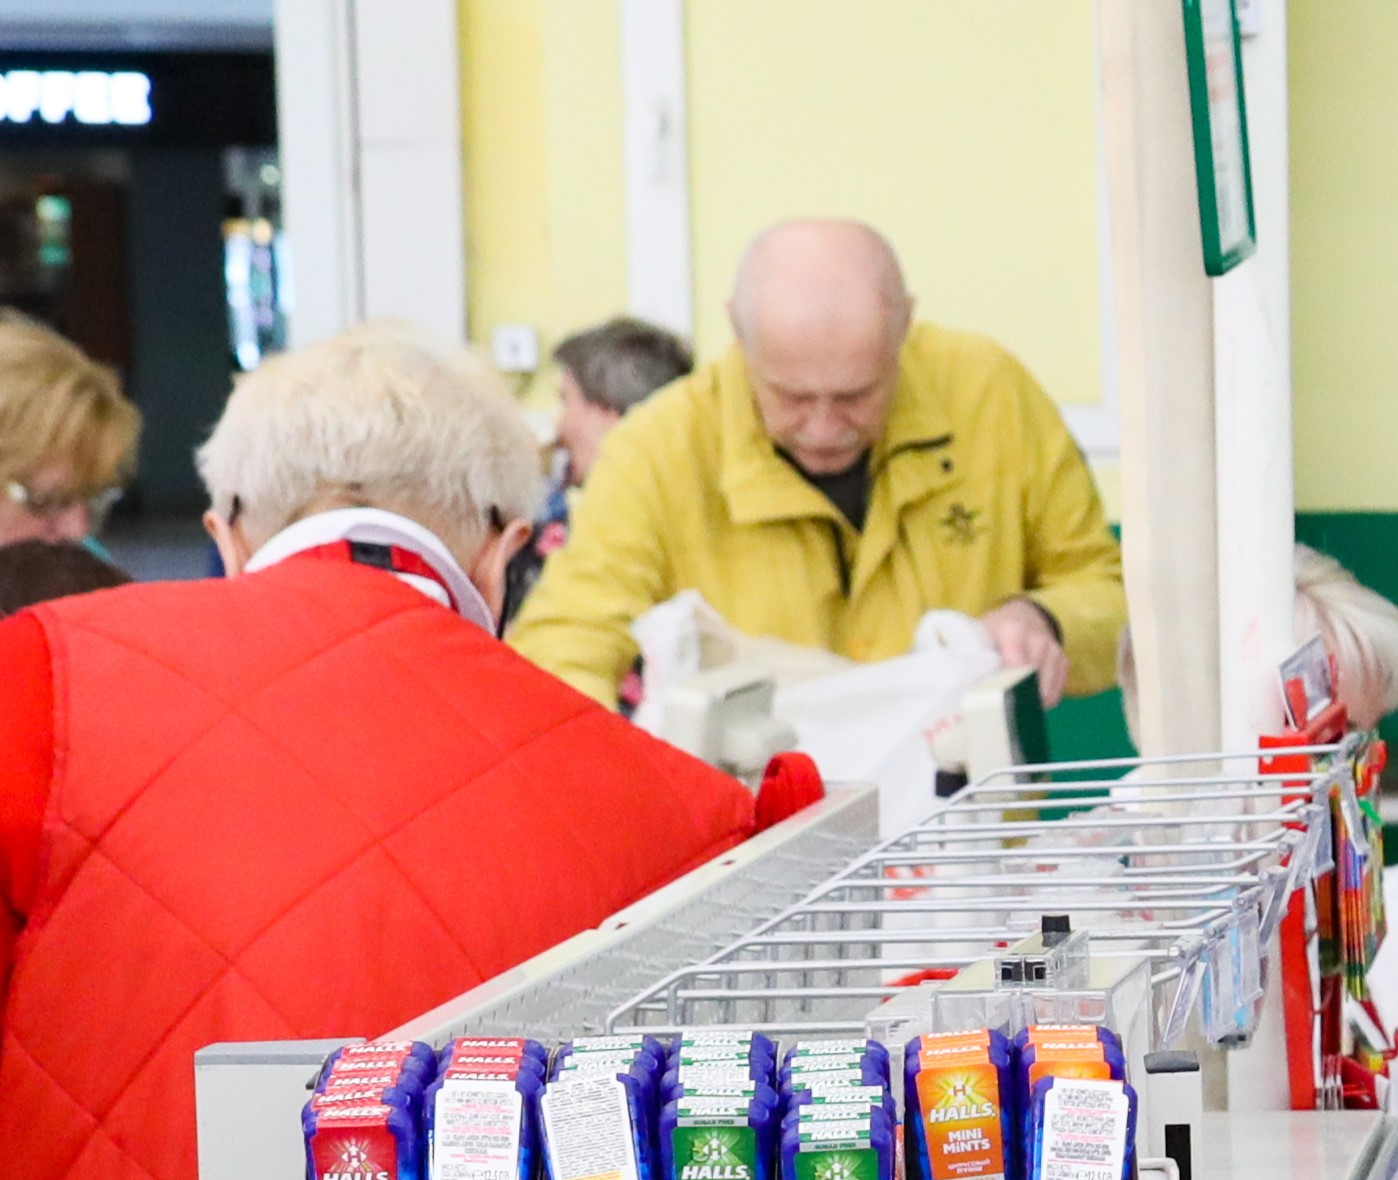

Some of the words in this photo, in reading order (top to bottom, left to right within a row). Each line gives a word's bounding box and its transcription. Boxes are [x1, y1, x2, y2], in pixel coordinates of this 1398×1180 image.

[0, 70, 152, 124] FFEE
[335, 1076, 391, 1085] HALLS
[324, 1107, 384, 1116] HALLS
[930, 1102, 995, 1123] HALLS
[681, 1165, 750, 1180] HALLS
